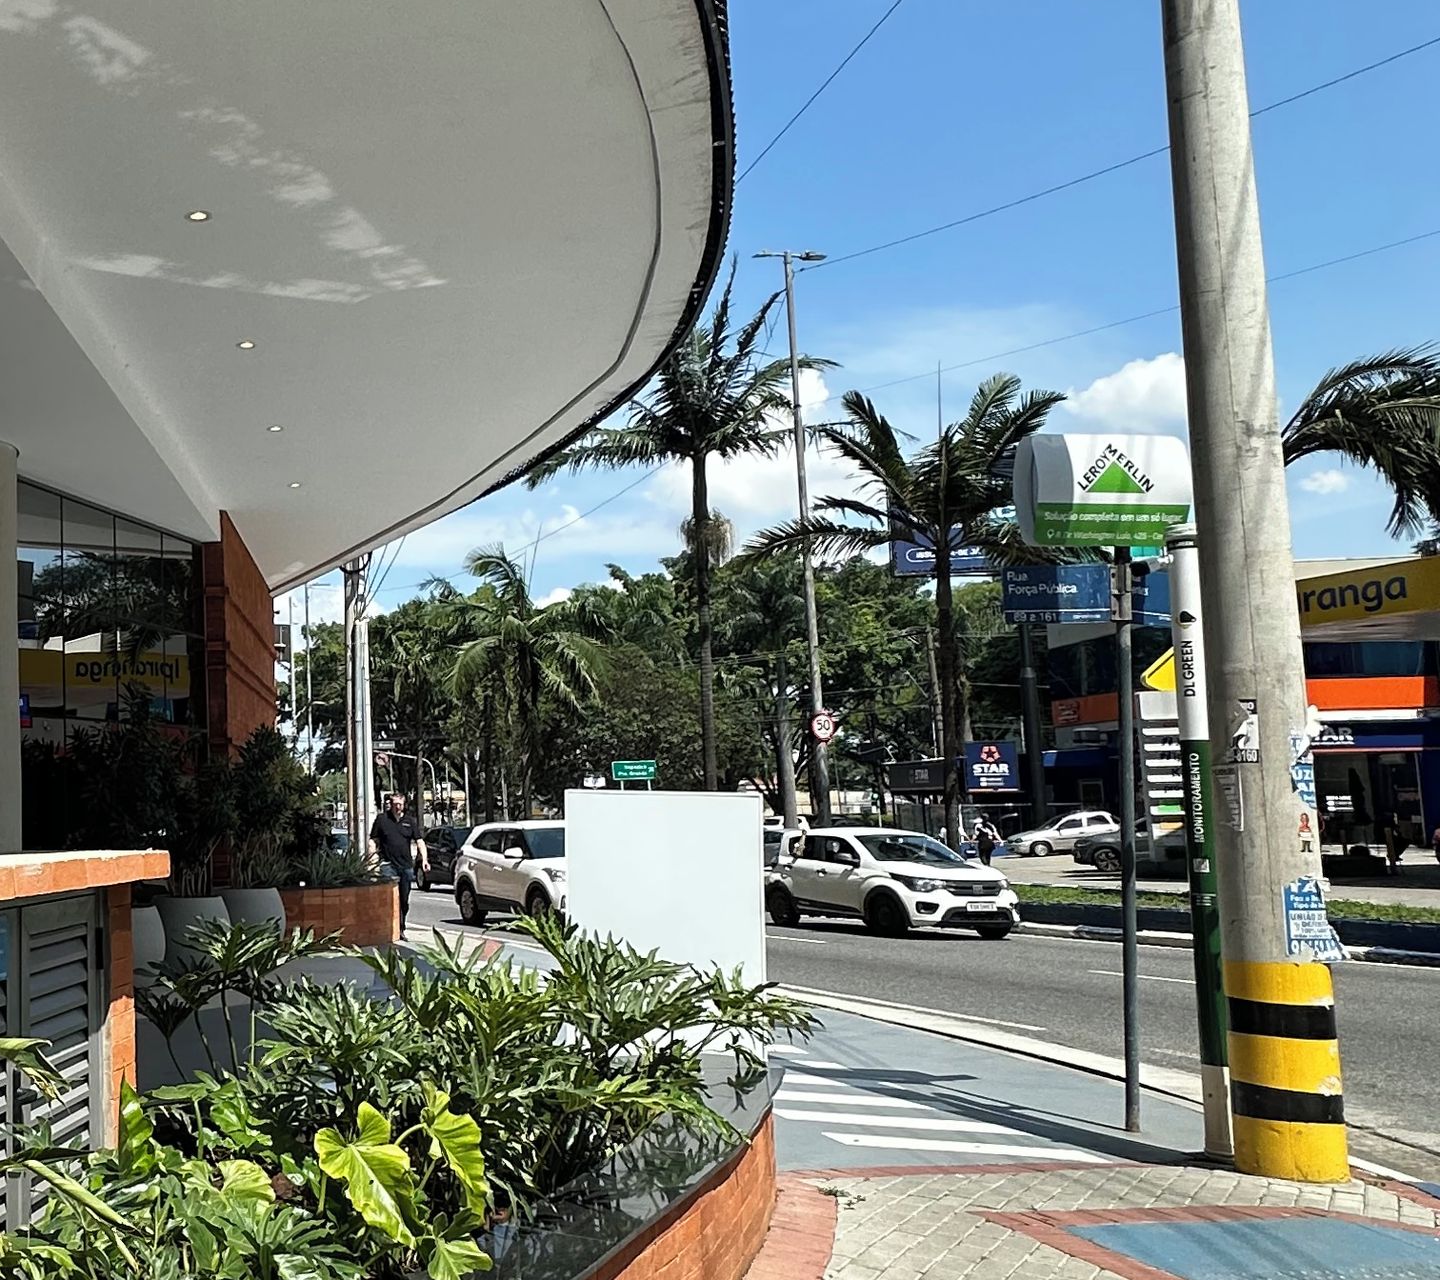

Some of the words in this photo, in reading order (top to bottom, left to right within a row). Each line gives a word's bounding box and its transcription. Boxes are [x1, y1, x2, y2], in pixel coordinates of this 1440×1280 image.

[1077, 451, 1111, 491] LEROY
[1105, 443, 1155, 493] MERLIN
[1044, 511, 1078, 522] Solução
[1079, 511, 1120, 522] completa
[1007, 571, 1028, 581] Rua
[1008, 583, 1038, 596] Força
[1039, 612, 1057, 622] 161
[1181, 640, 1194, 676] GREEN
[1184, 676, 1196, 697] DL
[816, 719, 831, 731] 50
[972, 763, 1010, 773] STAR
[1189, 752, 1205, 844] MONITORAMENTO
